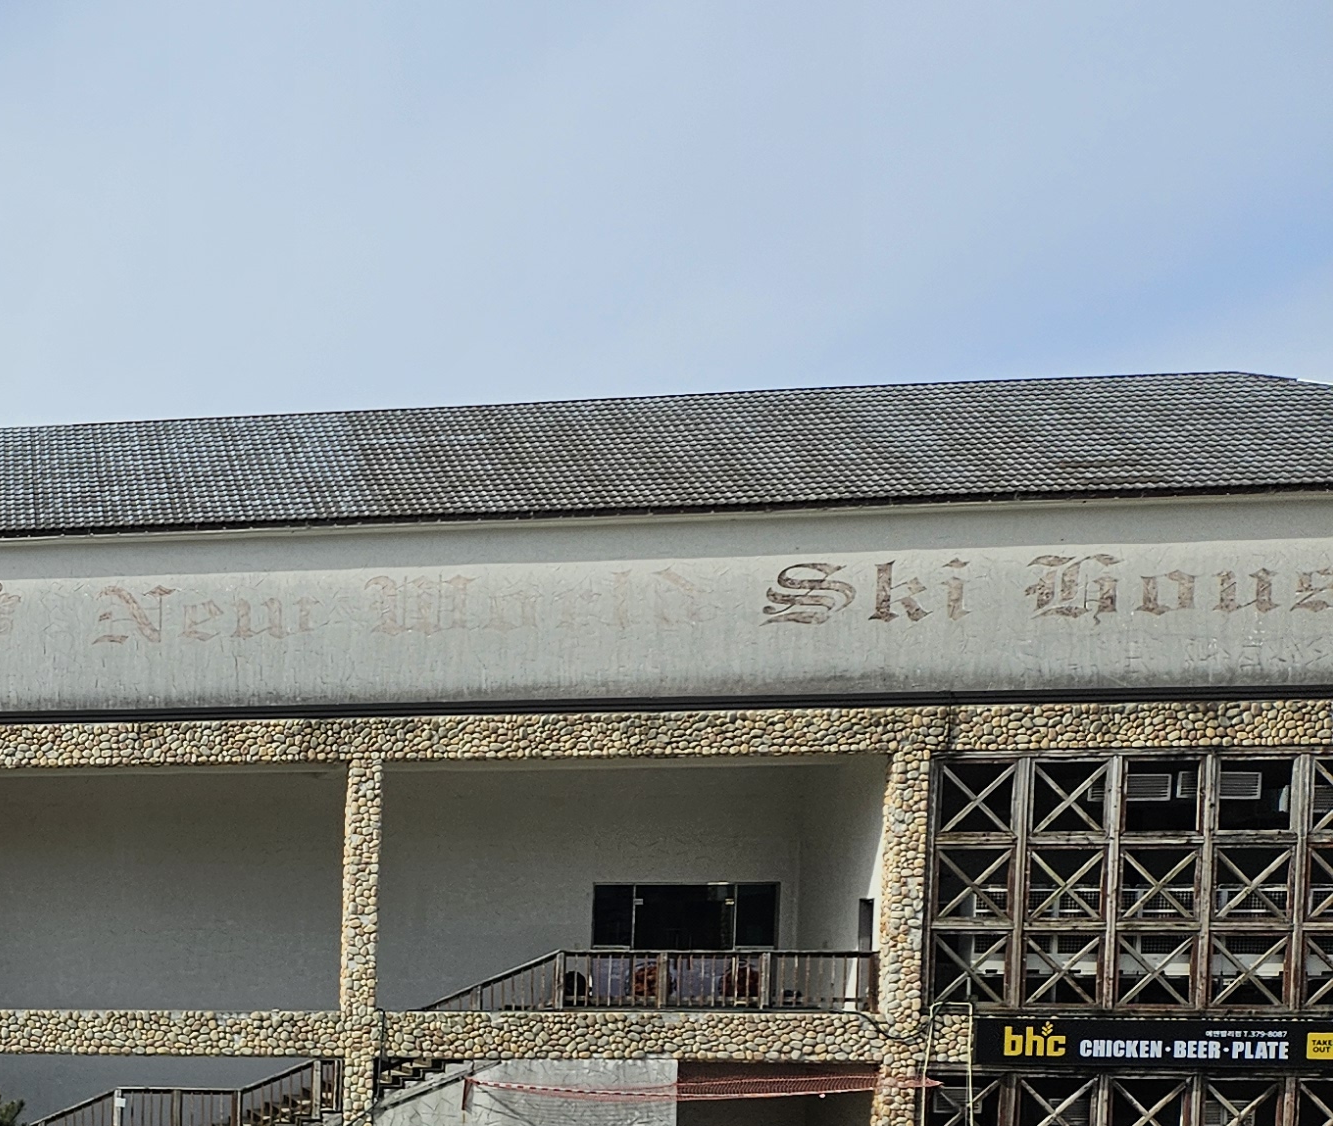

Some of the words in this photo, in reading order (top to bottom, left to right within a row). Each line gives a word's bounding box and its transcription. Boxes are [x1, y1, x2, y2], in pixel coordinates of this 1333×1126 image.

[758, 558, 970, 627] Ski
[1003, 1024, 1067, 1057] bhc
[1079, 1039, 1163, 1060] CHICKEN
